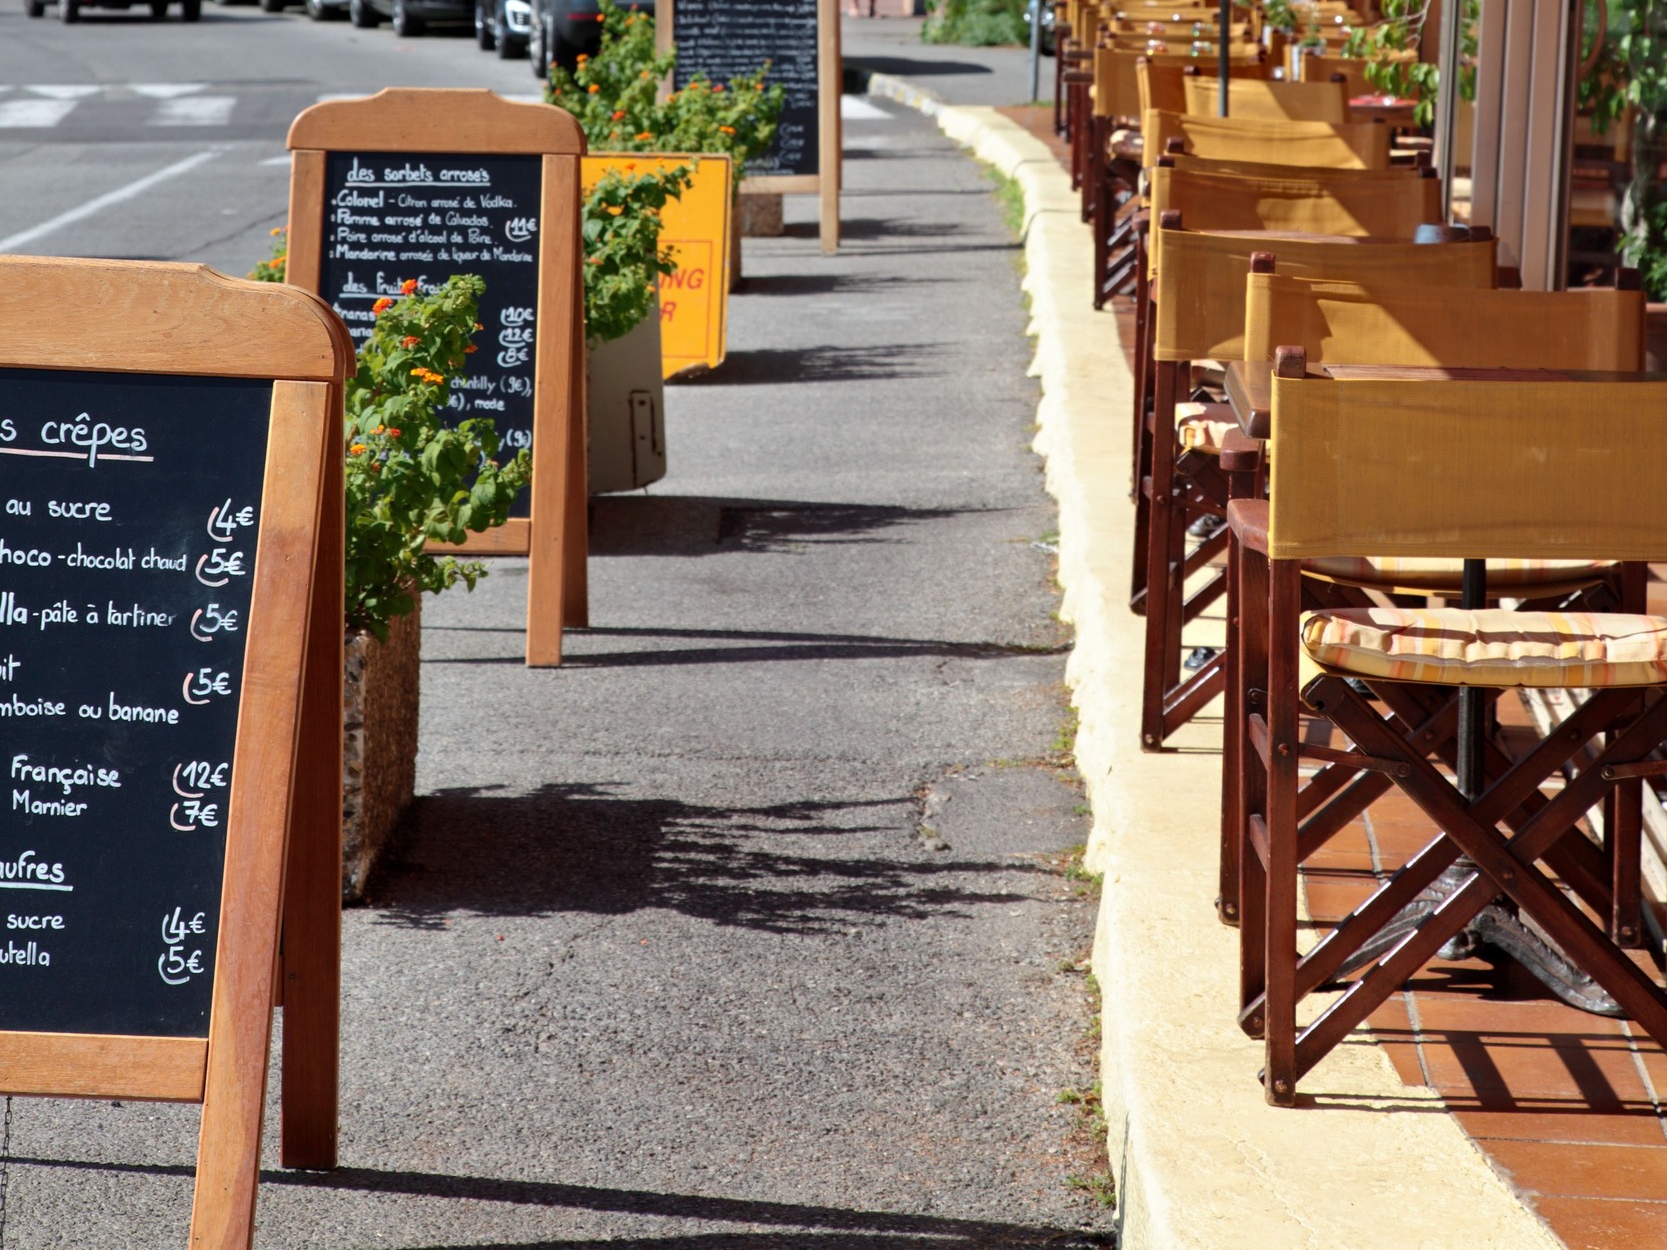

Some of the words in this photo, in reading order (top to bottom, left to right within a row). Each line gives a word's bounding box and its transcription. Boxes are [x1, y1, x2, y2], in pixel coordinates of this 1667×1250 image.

[384, 163, 433, 182] sorbets
[440, 168, 490, 182] arrosés
[337, 189, 384, 208] Colonel
[463, 196, 477, 208] de
[337, 208, 380, 226] Pomme
[428, 212, 442, 225] de
[337, 227, 367, 243] Poire
[450, 231, 464, 244] de
[336, 244, 397, 261] Mandarine
[437, 248, 451, 261] de
[41, 412, 147, 468] crêpes
[6, 499, 31, 516] au
[48, 500, 112, 521] sucre
[141, 547, 187, 571] chaud
[107, 601, 177, 627] tartiner
[0, 654, 21, 681] it
[78, 704, 102, 718] ou
[109, 691, 179, 724] banane
[11, 755, 121, 794] Française
[12, 790, 87, 816] Marnier
[7, 914, 65, 929] sucre
